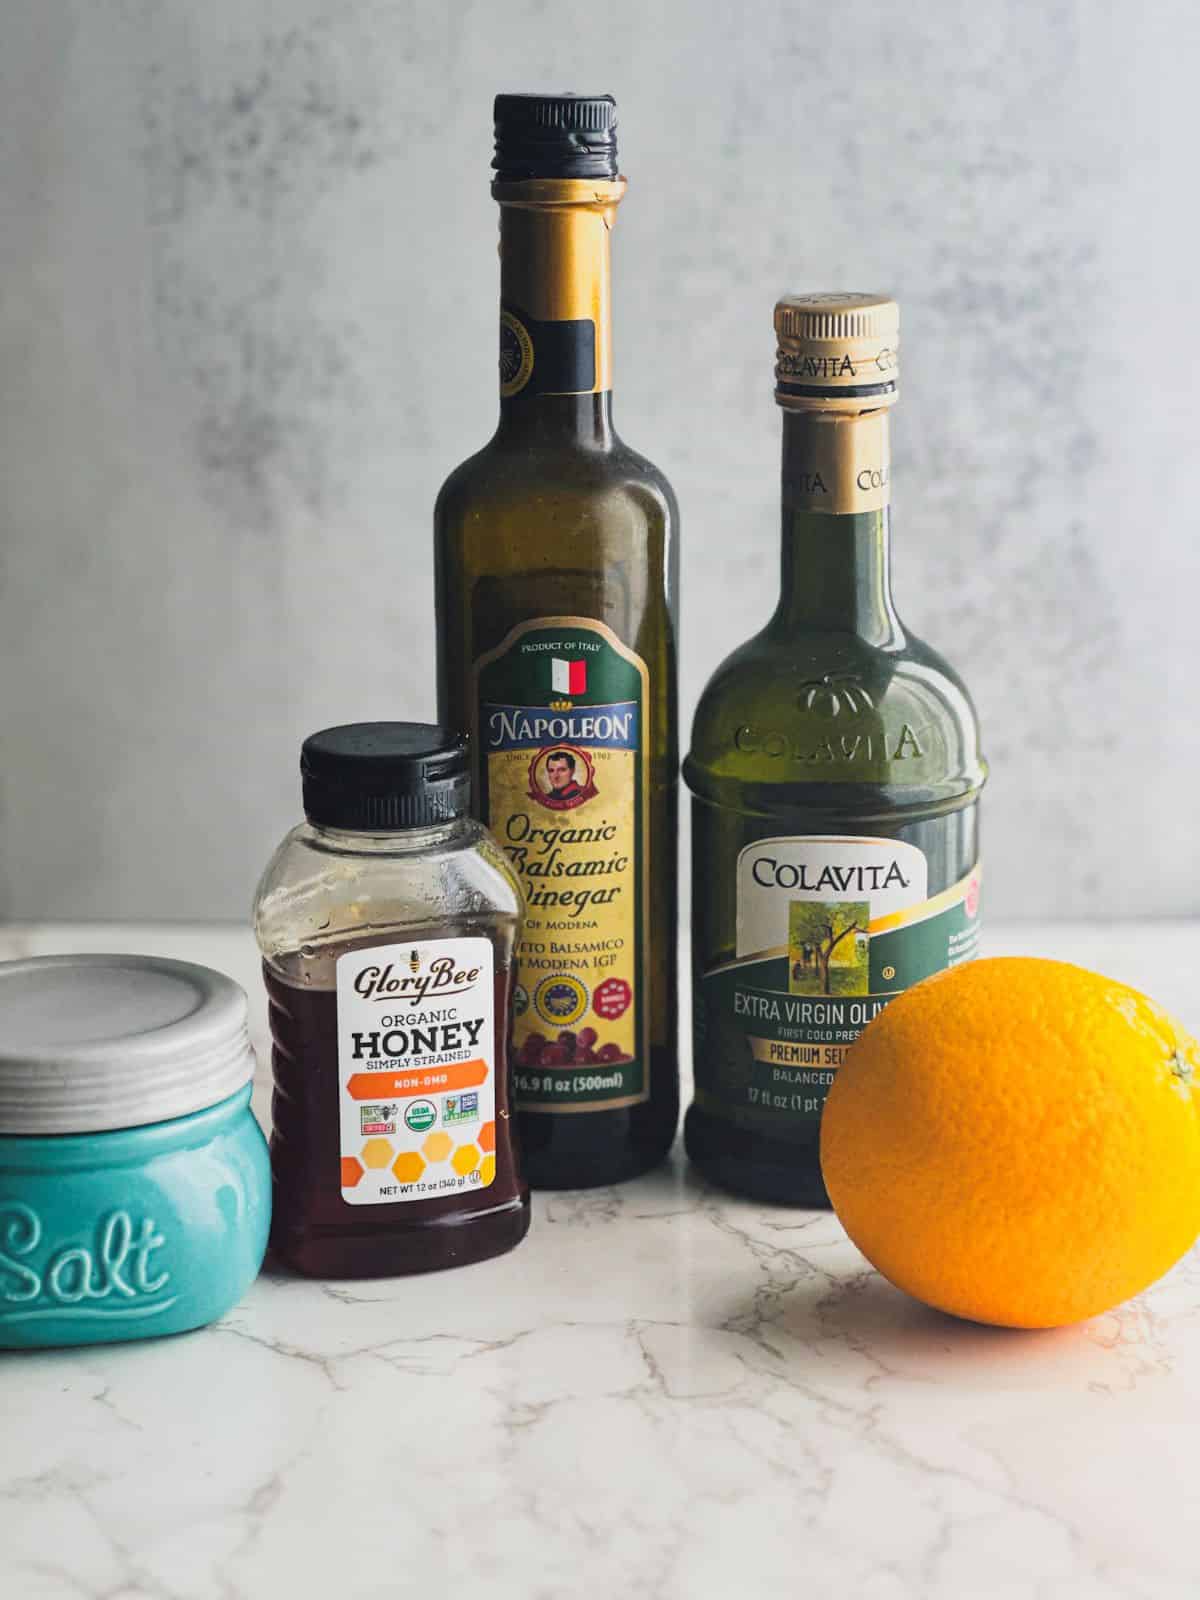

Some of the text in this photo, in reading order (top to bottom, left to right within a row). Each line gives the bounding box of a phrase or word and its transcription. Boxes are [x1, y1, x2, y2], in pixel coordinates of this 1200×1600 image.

[521, 641, 601, 653] PRODUCT OF ITALY
[489, 710, 633, 747] NAPOLEON
[505, 813, 617, 855] Organic
[752, 857, 907, 891] COLAVITA
[526, 919, 599, 930] OF MODENA
[550, 938, 624, 953] BALSAMICO
[527, 958, 590, 970] MODENA
[593, 954, 617, 968] IGP
[354, 957, 480, 1006] GloryBee
[381, 1008, 457, 1027] ORGANIC
[734, 992, 781, 1020] EXTRA
[785, 1002, 844, 1025] VIRGIN
[351, 1018, 485, 1059] HONEY
[777, 1026, 865, 1041] FIRST COLD PRES
[366, 1050, 472, 1070] SIMPLY STRAINED
[770, 1043, 820, 1065] PREMIUM
[393, 1075, 448, 1088] NON-GMO
[555, 1080, 571, 1092] oz
[573, 1072, 624, 1093] (500ml)
[773, 1069, 834, 1085] BALANCED
[774, 1096, 787, 1108] oz
[804, 1097, 819, 1112] pt
[379, 1186, 397, 1196] NET
[399, 1185, 414, 1194] WT
[416, 1183, 426, 1191] 12
[428, 1183, 438, 1191] oz
[0, 1202, 171, 1303] Salt
